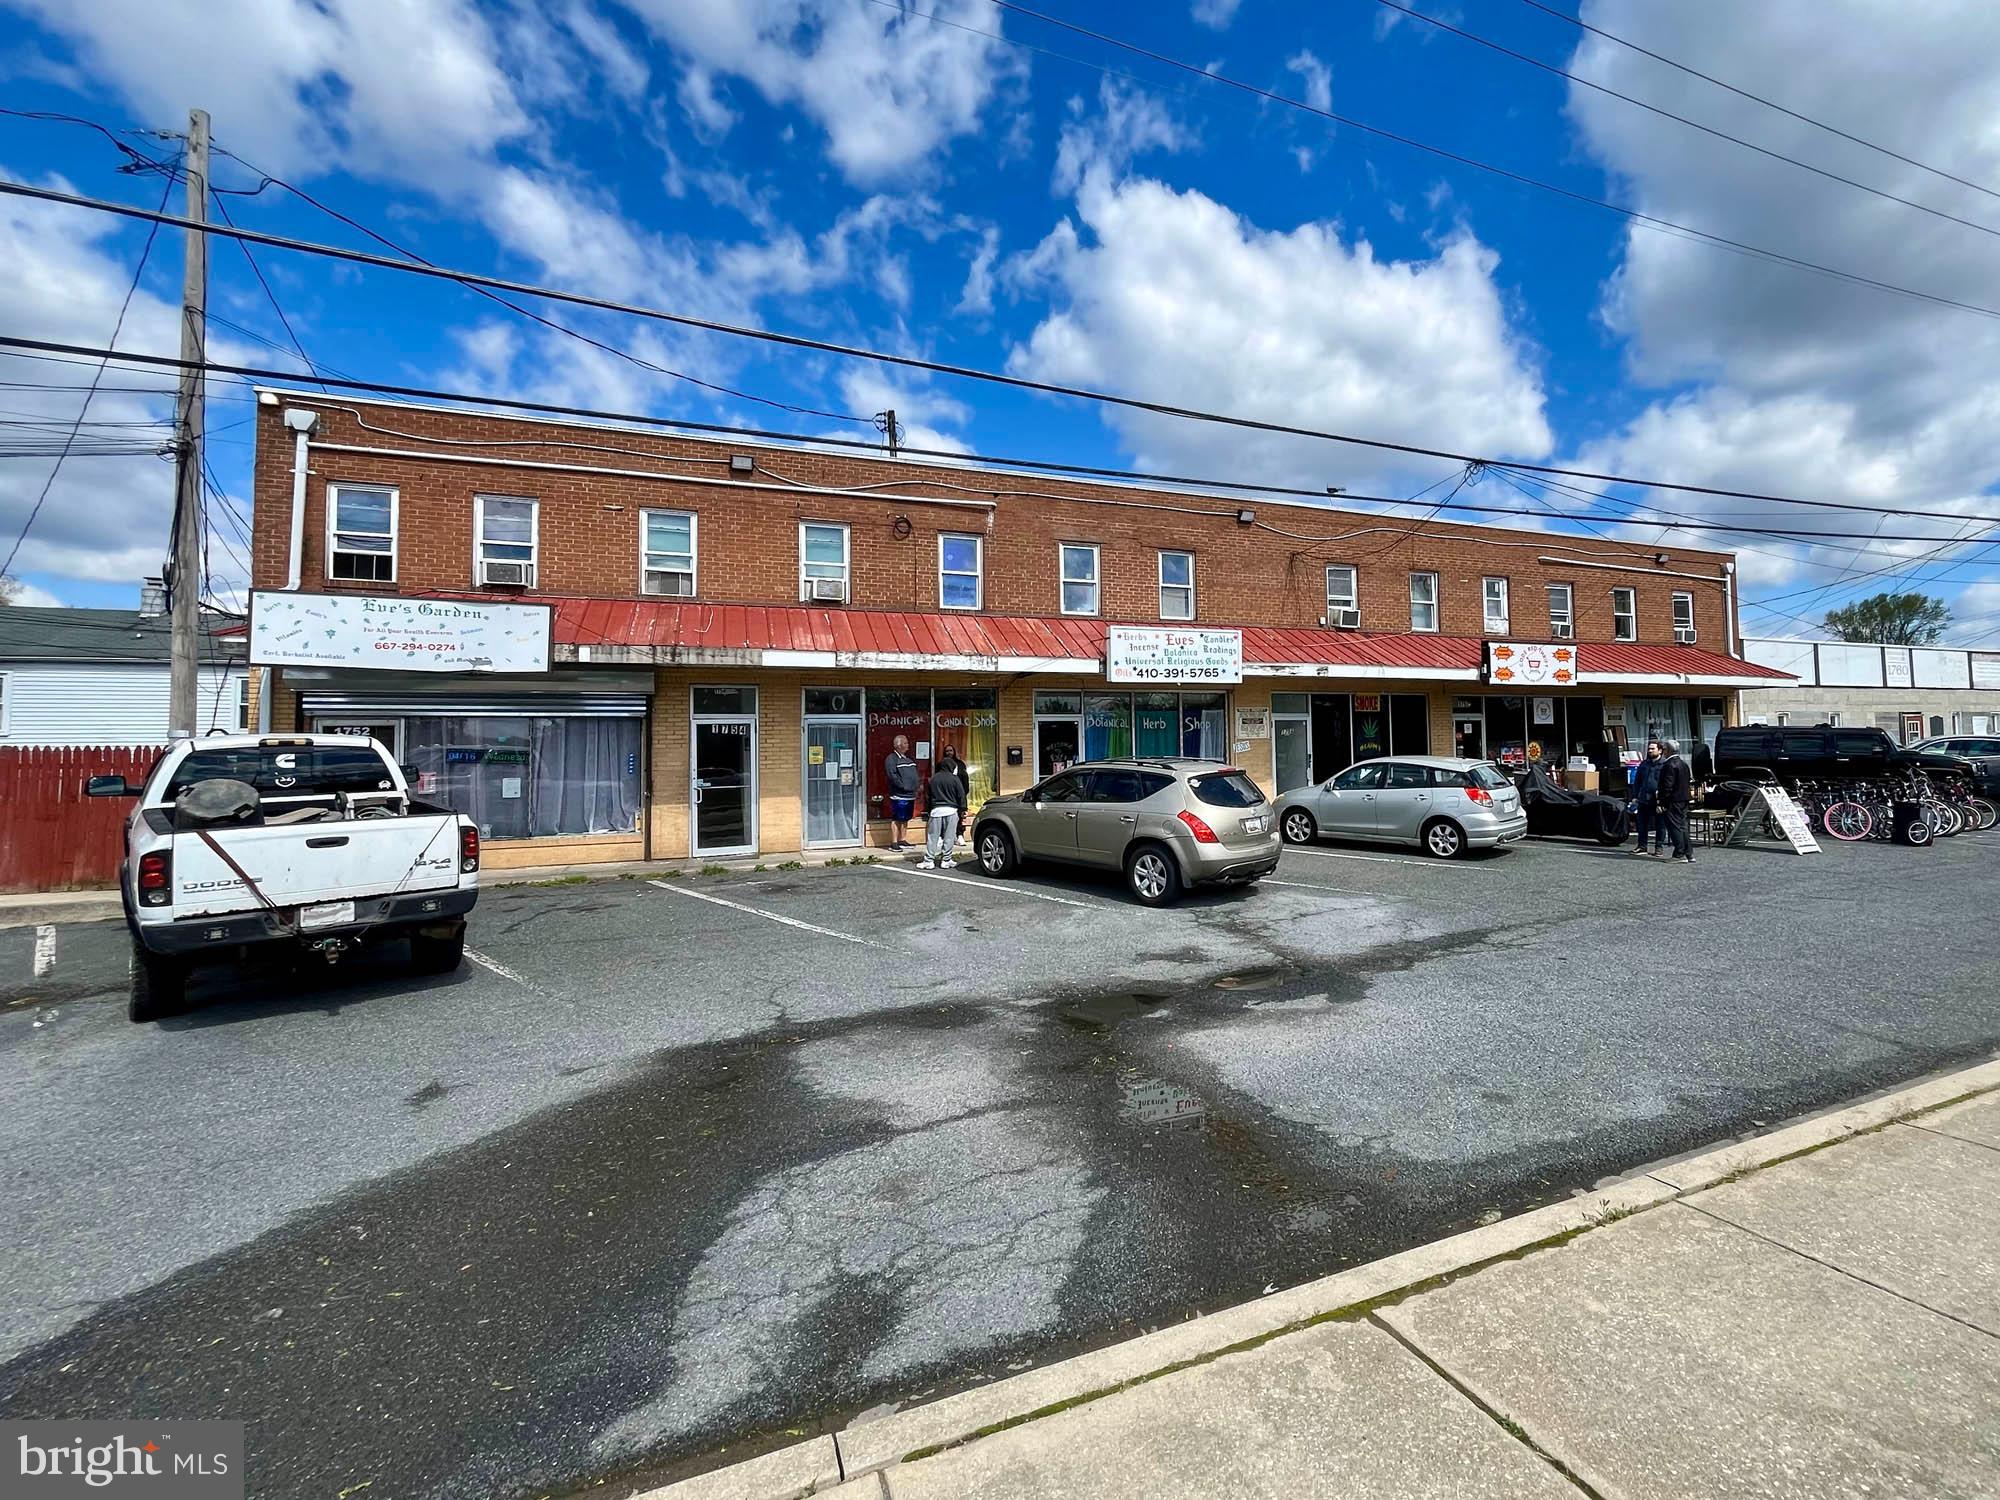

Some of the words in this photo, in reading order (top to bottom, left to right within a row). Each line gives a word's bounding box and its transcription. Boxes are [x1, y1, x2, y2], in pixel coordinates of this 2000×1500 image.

[418, 603, 481, 619] Garden
[1123, 632, 1148, 641] Herbs
[1164, 633, 1195, 646] Eves
[1203, 635, 1234, 644] Candles
[374, 642, 456, 652] 667-294-0274
[1129, 643, 1159, 651] Incense
[1203, 645, 1237, 656] Readings
[1125, 656, 1164, 665] Universal
[1167, 657, 1204, 666] Religious
[1137, 668, 1219, 678] 410-391-5765
[712, 724, 747, 735] 1754
[1143, 717, 1167, 729] Herb
[1184, 717, 1212, 732] Shop
[334, 726, 371, 736] 1752
